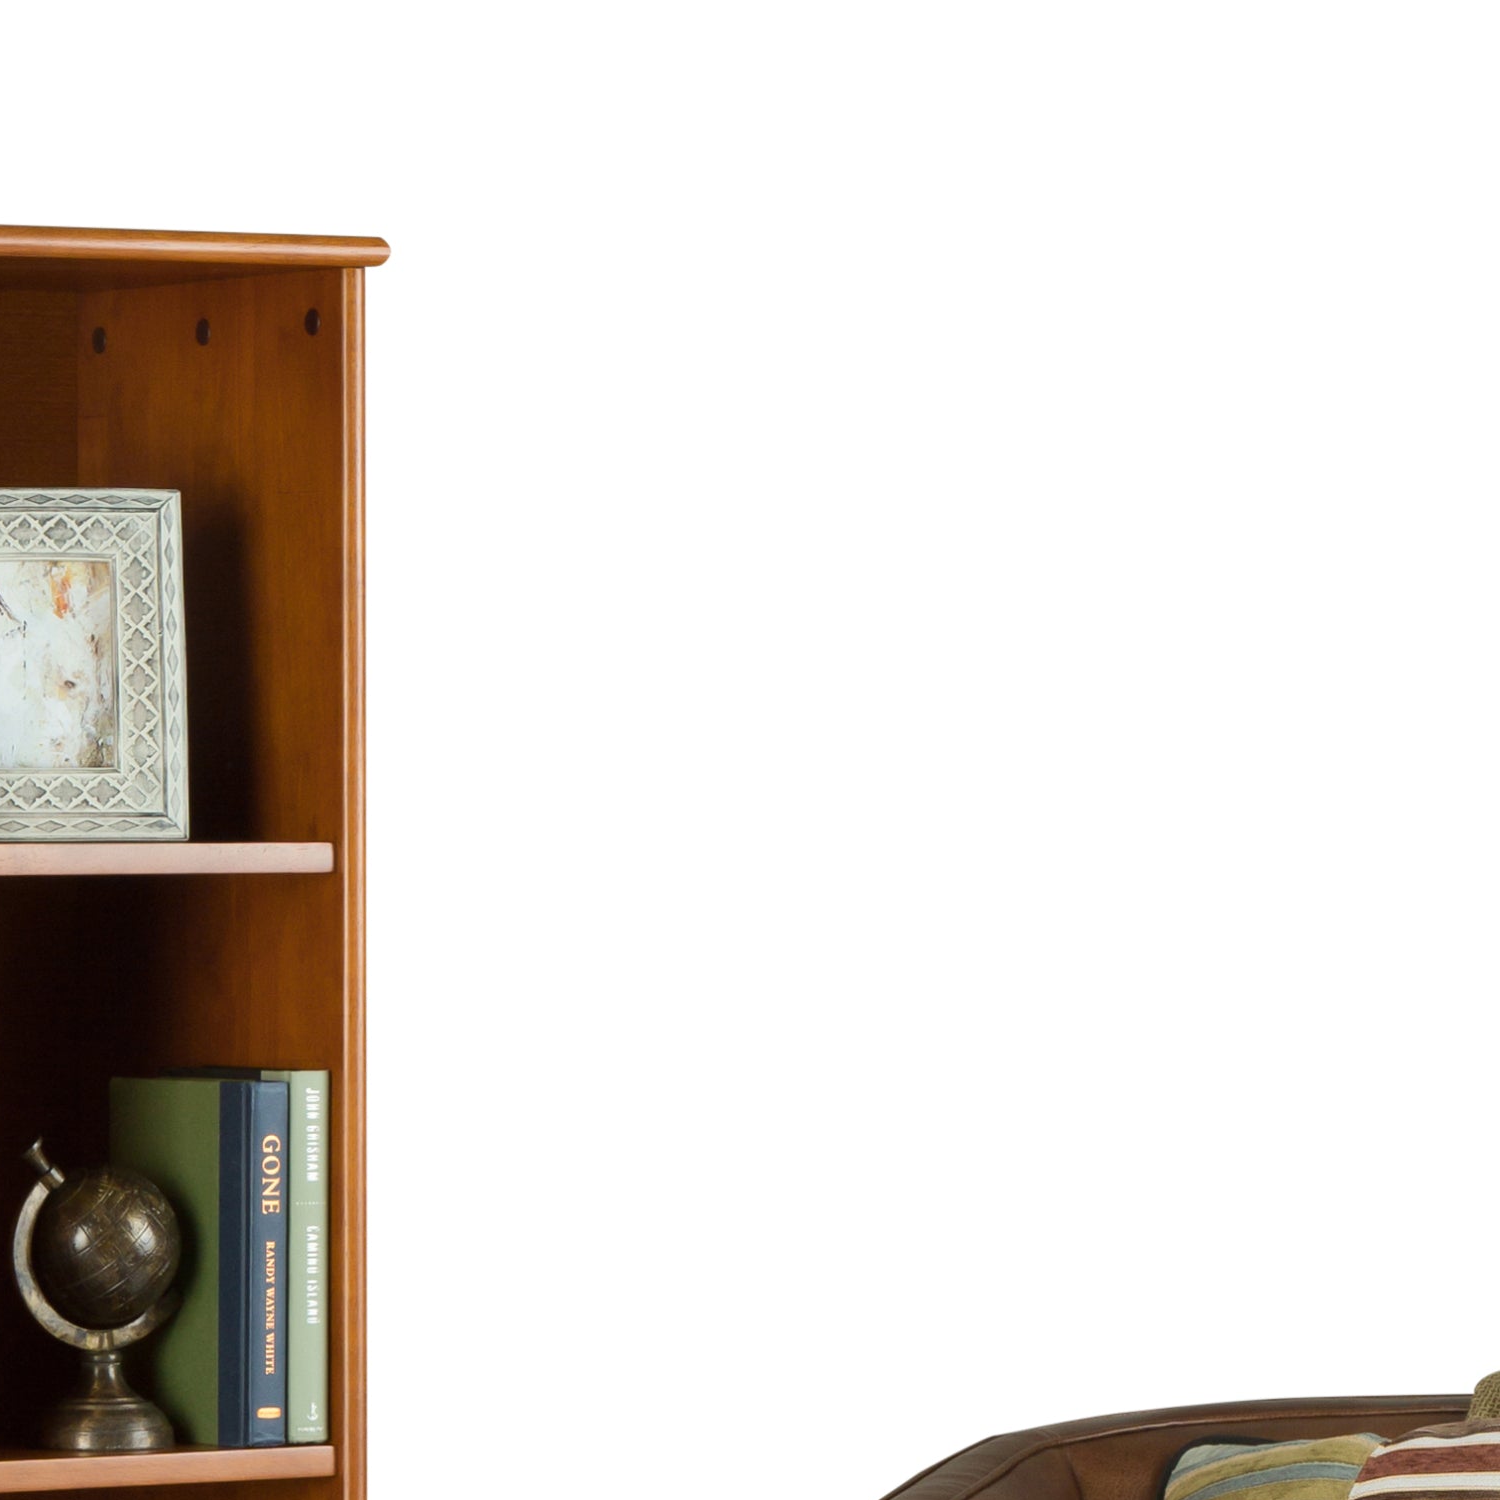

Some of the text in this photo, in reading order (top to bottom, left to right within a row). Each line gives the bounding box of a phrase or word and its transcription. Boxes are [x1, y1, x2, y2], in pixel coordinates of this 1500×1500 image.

[261, 1133, 282, 1215] GONE
[305, 1087, 321, 1183] JOHN GRISHAM
[265, 1240, 276, 1376] RANDY WAYNE WHITE
